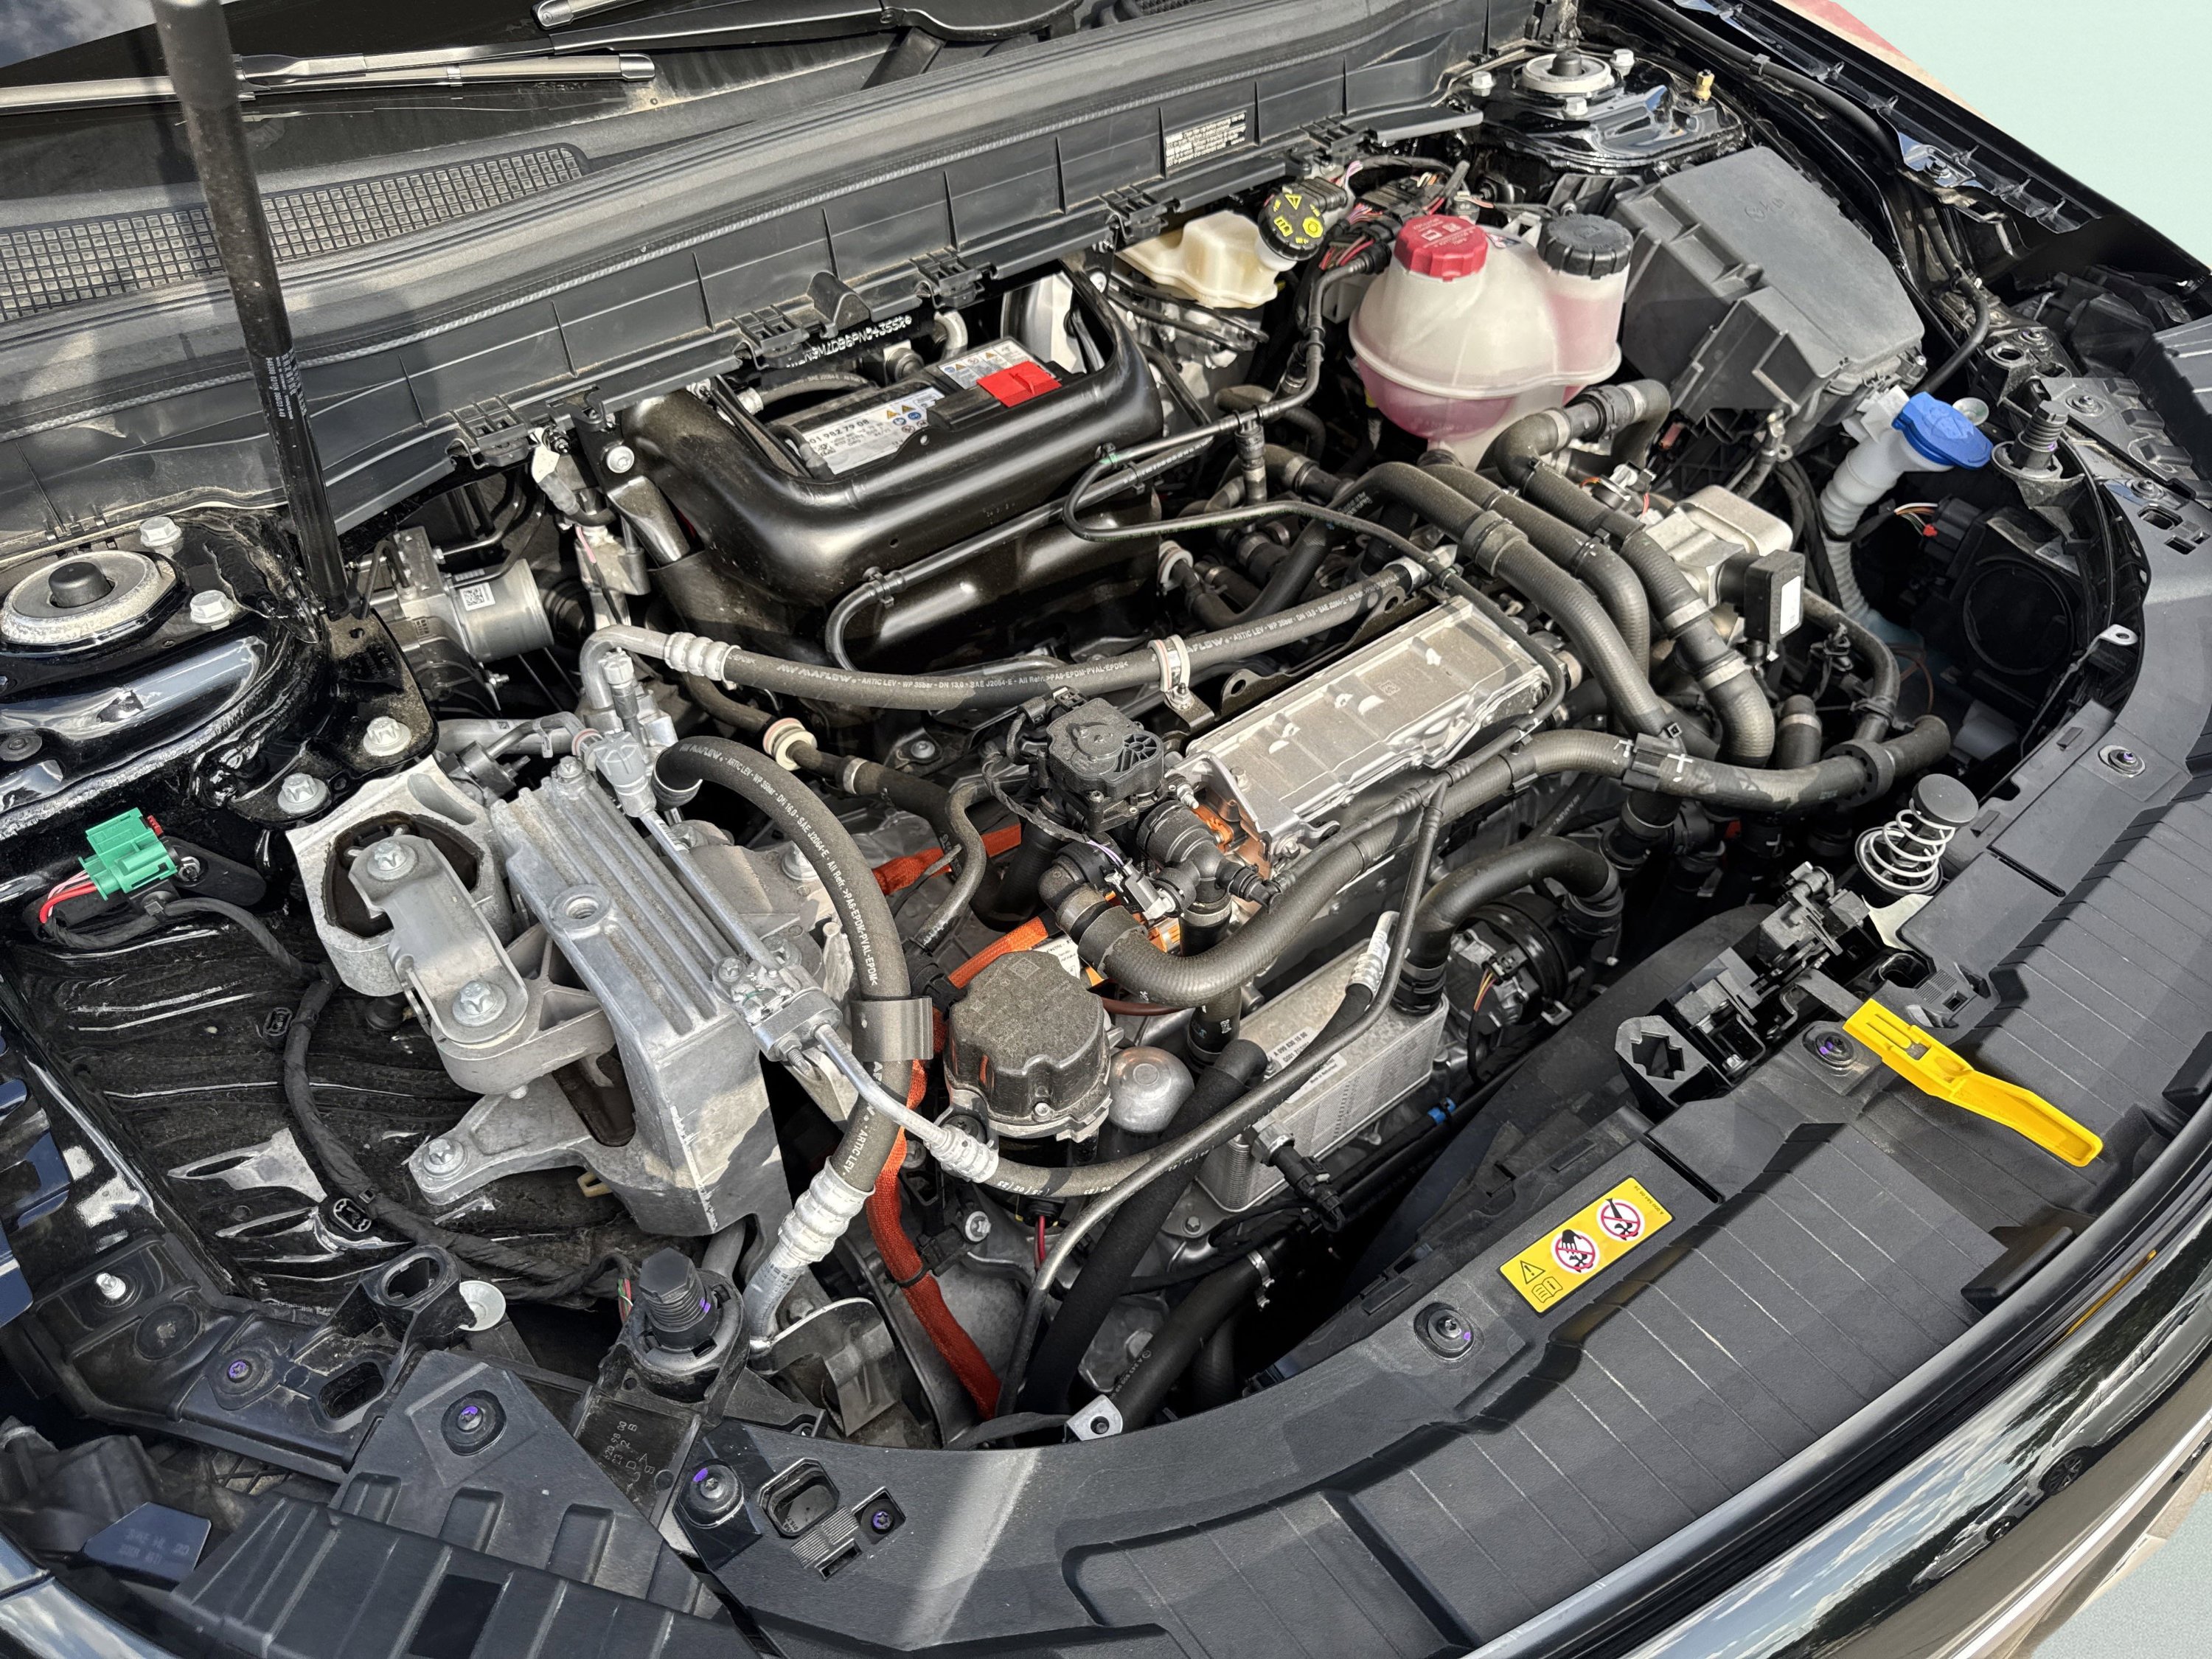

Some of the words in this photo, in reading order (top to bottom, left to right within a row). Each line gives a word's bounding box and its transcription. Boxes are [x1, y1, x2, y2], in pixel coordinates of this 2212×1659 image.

[1187, 637, 1224, 654] AFLOW
[1253, 627, 1265, 637] LEV
[1267, 622, 1278, 631] WP
[861, 678, 883, 686] ARTIC
[914, 681, 933, 689] 35bar
[970, 681, 984, 689] SAE
[1019, 677, 1028, 685] All
[740, 765, 752, 777] LEV
[753, 773, 764, 785] WP
[760, 779, 776, 796] 35bar
[776, 794, 786, 807] DN
[785, 803, 798, 818] 16,0
[796, 817, 811, 834] SAE
[807, 830, 830, 858] J2064-E
[827, 860, 835, 872] All
[852, 1129, 868, 1156] ARTIC
[843, 1154, 858, 1173] LEV
